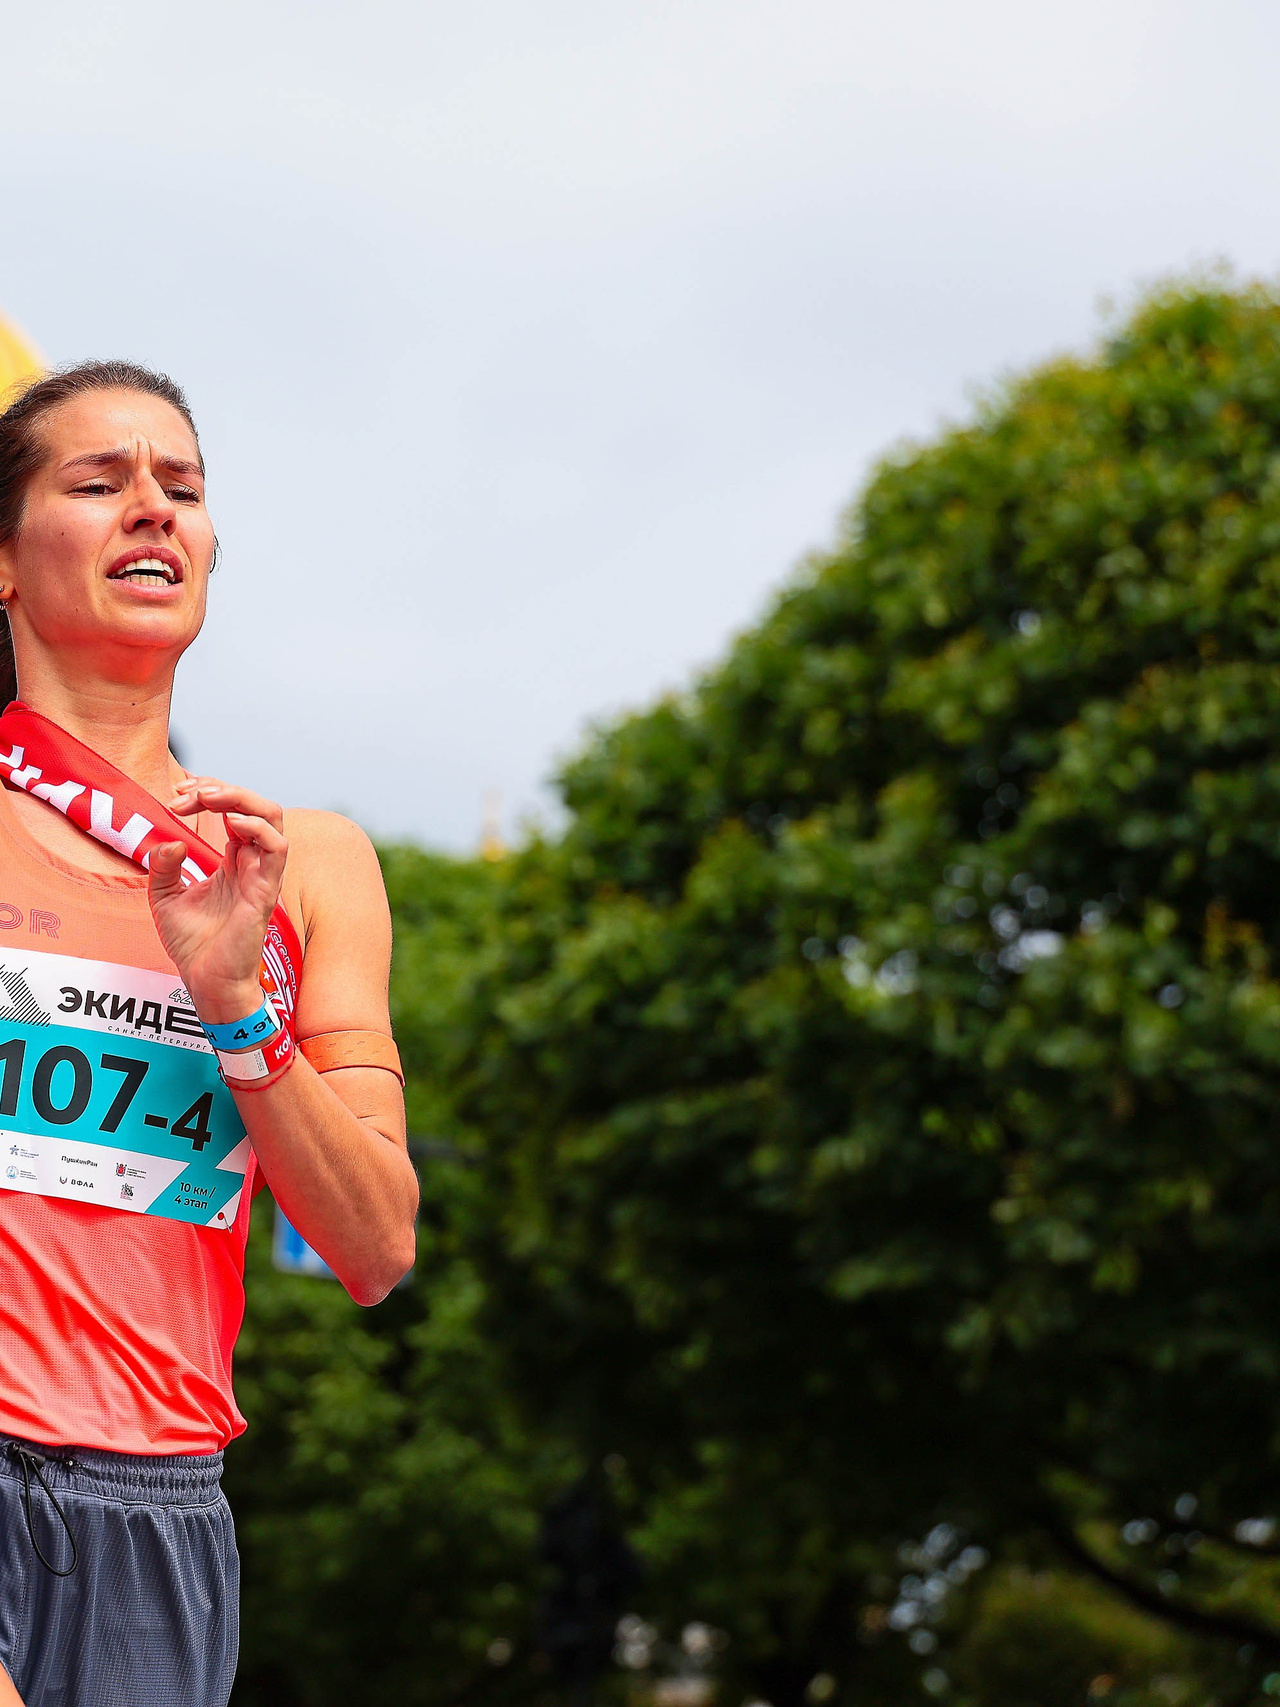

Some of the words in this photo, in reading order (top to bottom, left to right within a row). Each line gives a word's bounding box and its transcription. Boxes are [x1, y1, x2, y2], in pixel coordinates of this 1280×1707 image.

[107, 1025, 207, 1050] САНКТ-ПЕТЕРБУРГ
[233, 1027, 250, 1040] 4
[70, 1178, 94, 1189] ВФЛА
[180, 1182, 191, 1193] 10
[193, 1186, 208, 1197] км
[174, 1194, 182, 1204] 4
[183, 1198, 208, 1210] этап
